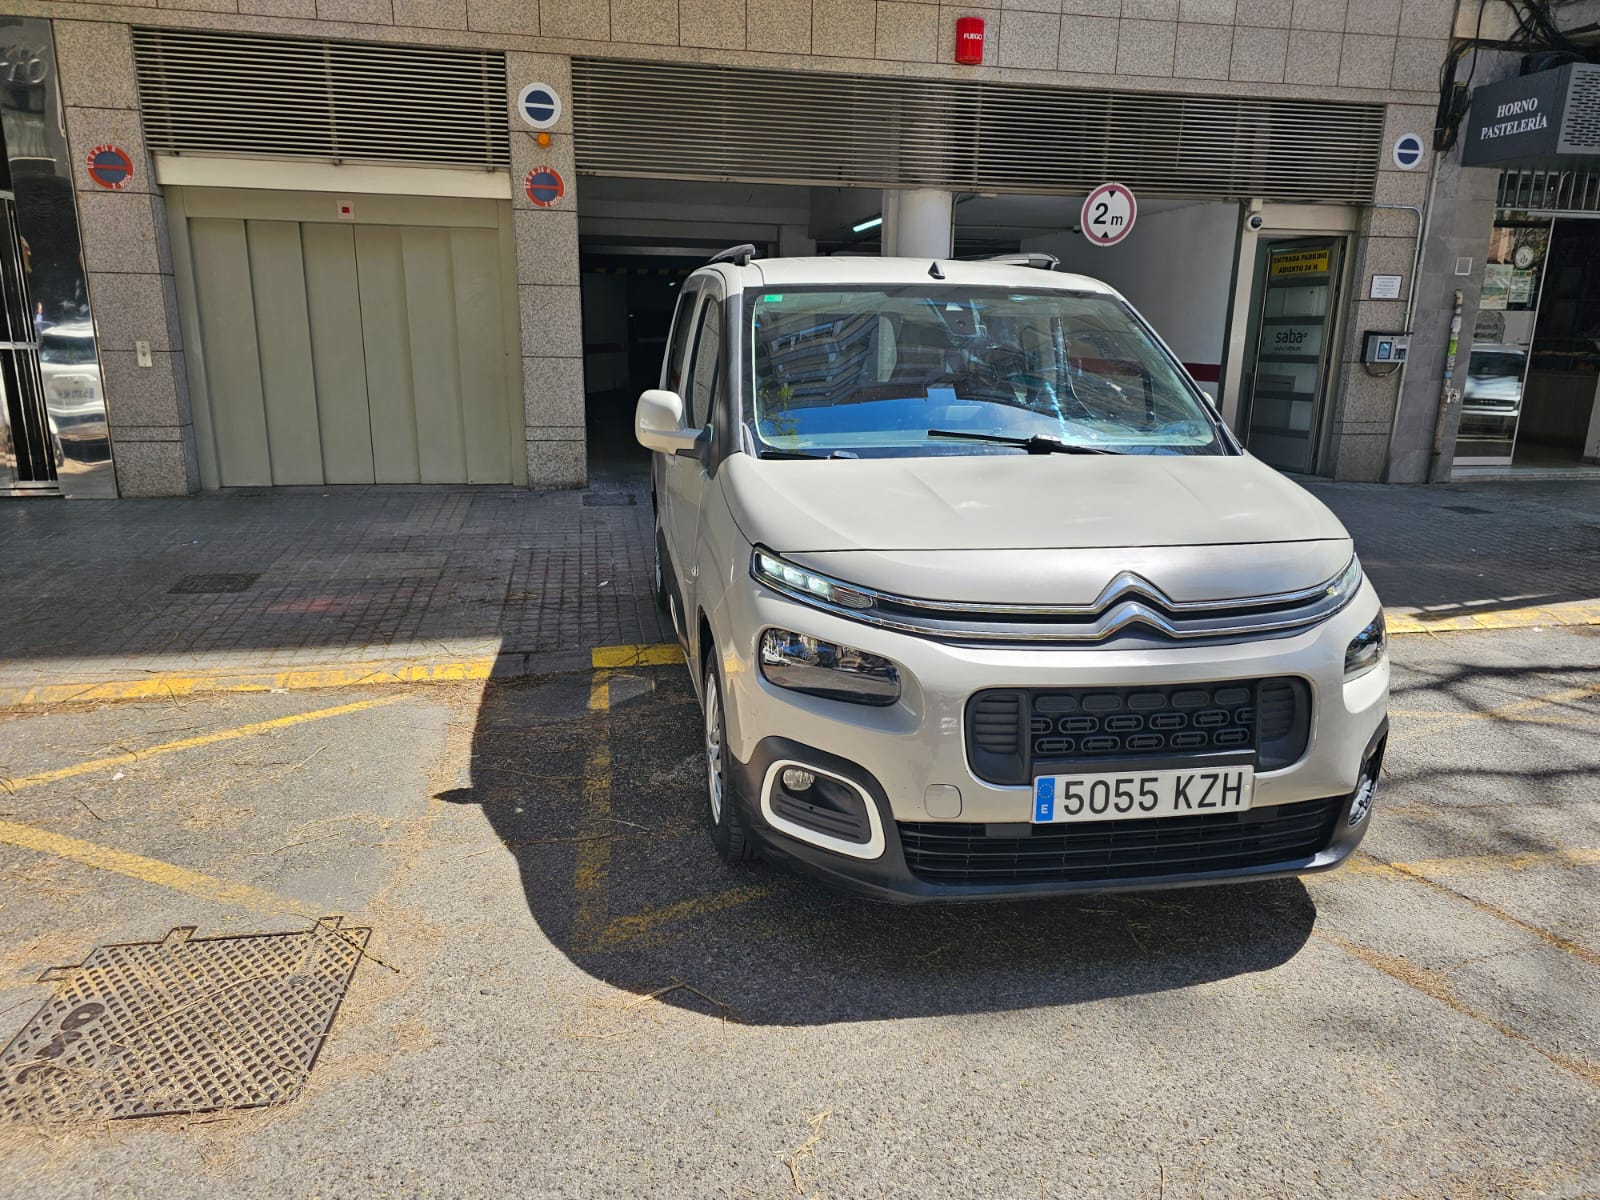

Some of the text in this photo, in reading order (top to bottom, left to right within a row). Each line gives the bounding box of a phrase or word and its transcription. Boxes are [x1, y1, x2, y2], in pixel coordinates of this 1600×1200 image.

[963, 32, 983, 40] FUEGO
[1496, 97, 1538, 118] HORNO
[1480, 112, 1548, 140] PASTELERÍA
[1093, 202, 1123, 226] 2 m
[1301, 251, 1328, 261] PARKING
[1063, 771, 1243, 816] 5055 KZH
[1041, 804, 1049, 814] E
